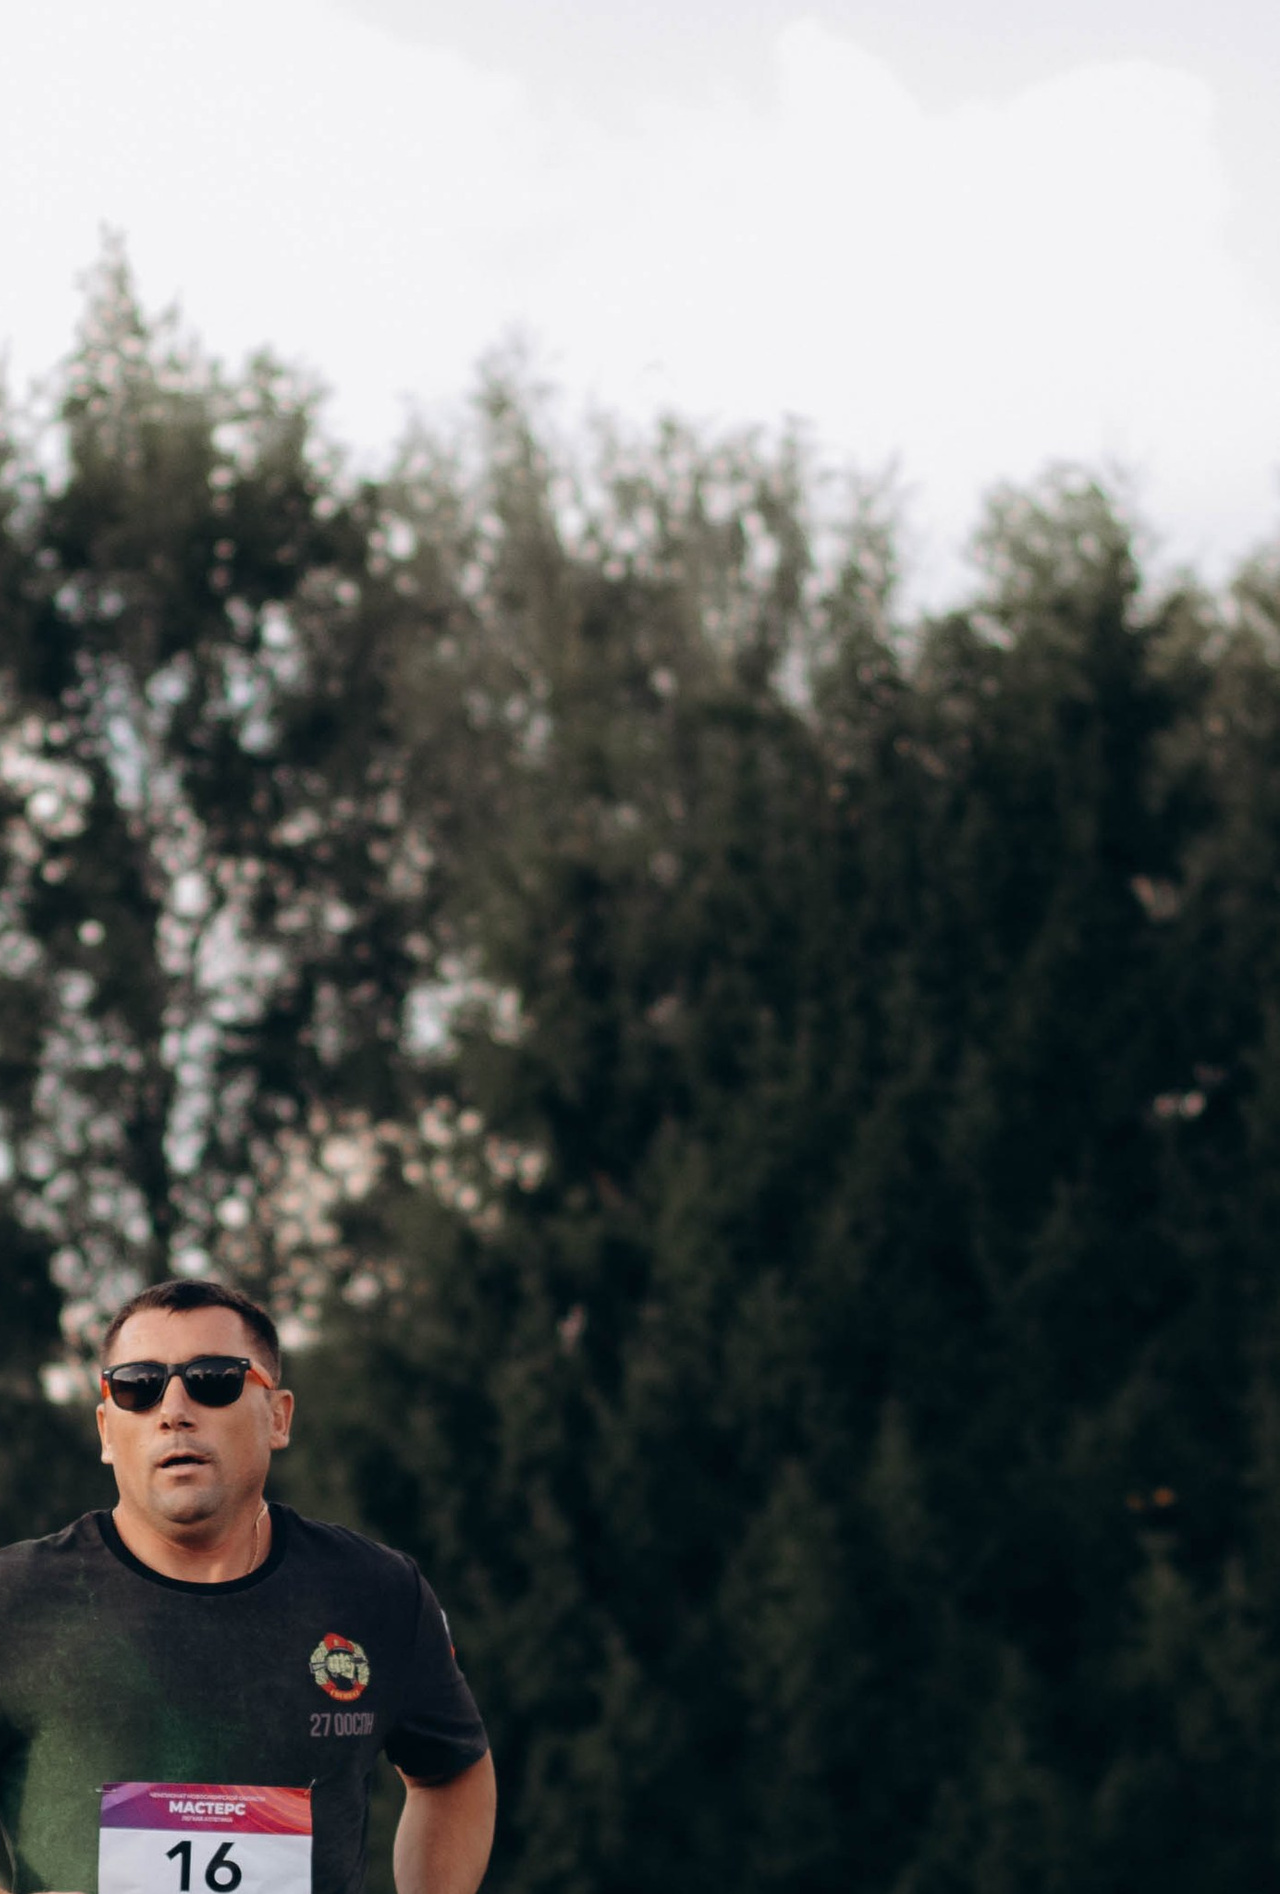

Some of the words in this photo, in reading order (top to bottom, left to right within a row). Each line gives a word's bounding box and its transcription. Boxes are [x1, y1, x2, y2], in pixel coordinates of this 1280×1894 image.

[310, 1713, 331, 1736] 27
[168, 1801, 246, 1816] МАСТЕРС
[165, 1840, 243, 1893] 16
